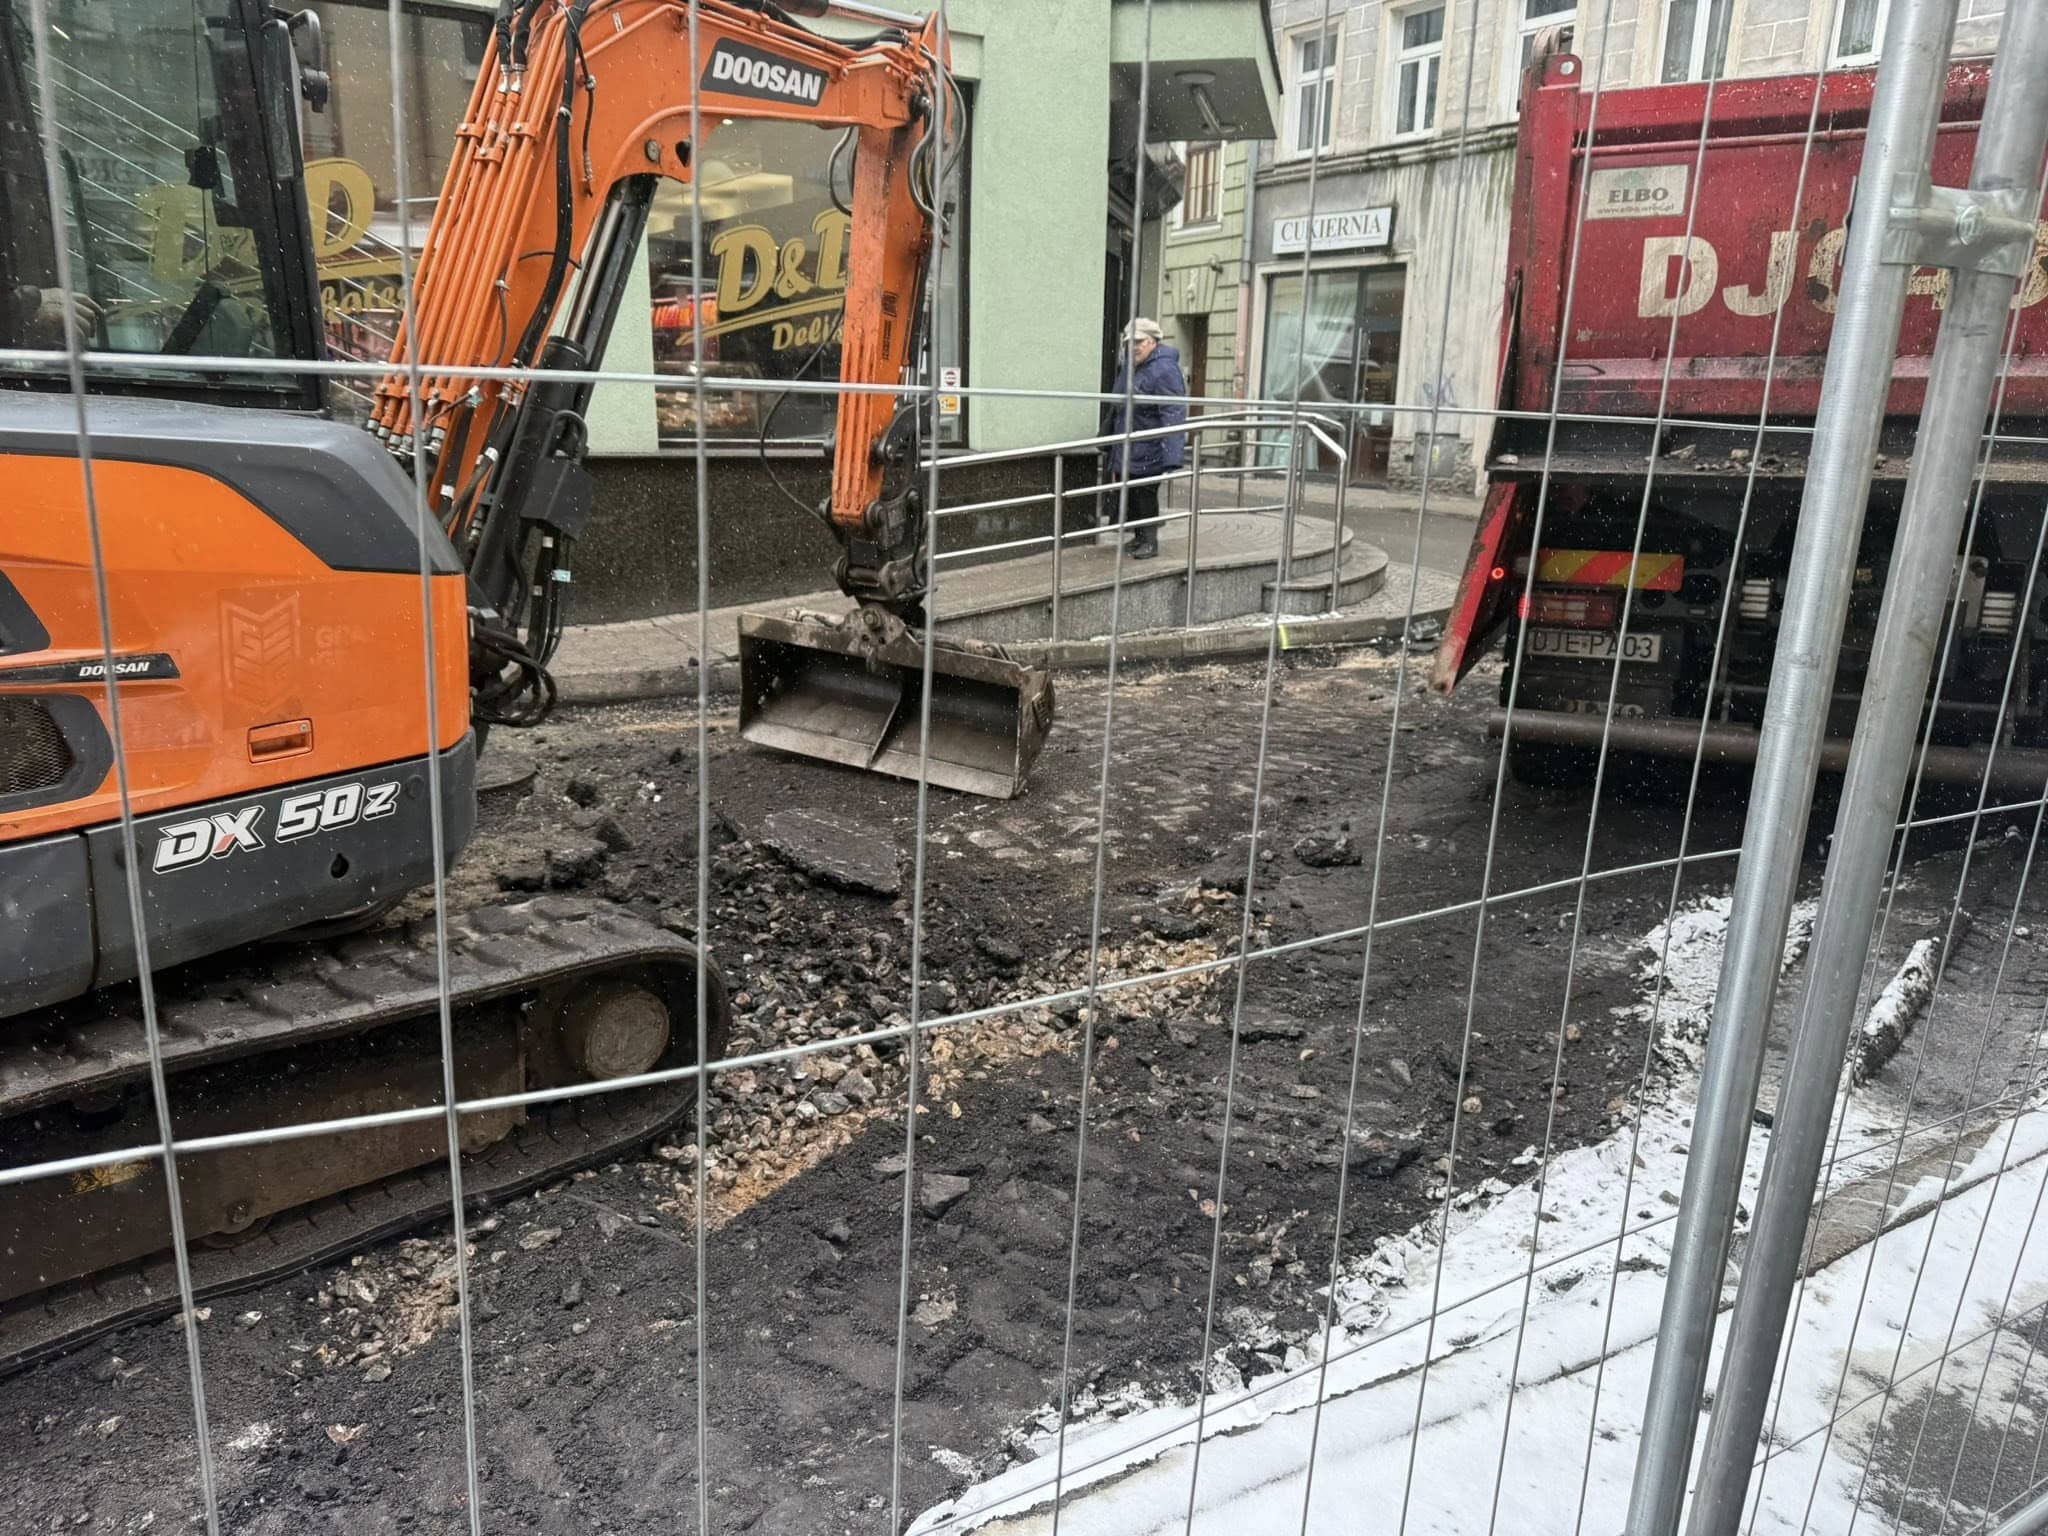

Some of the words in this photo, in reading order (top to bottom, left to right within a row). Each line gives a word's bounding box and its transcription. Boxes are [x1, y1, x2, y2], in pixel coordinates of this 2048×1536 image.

[711, 50, 822, 101] DOOSAN
[1608, 187, 1669, 203] ELBO
[1281, 214, 1381, 242] CUKIERNIA
[153, 805, 266, 875] DX
